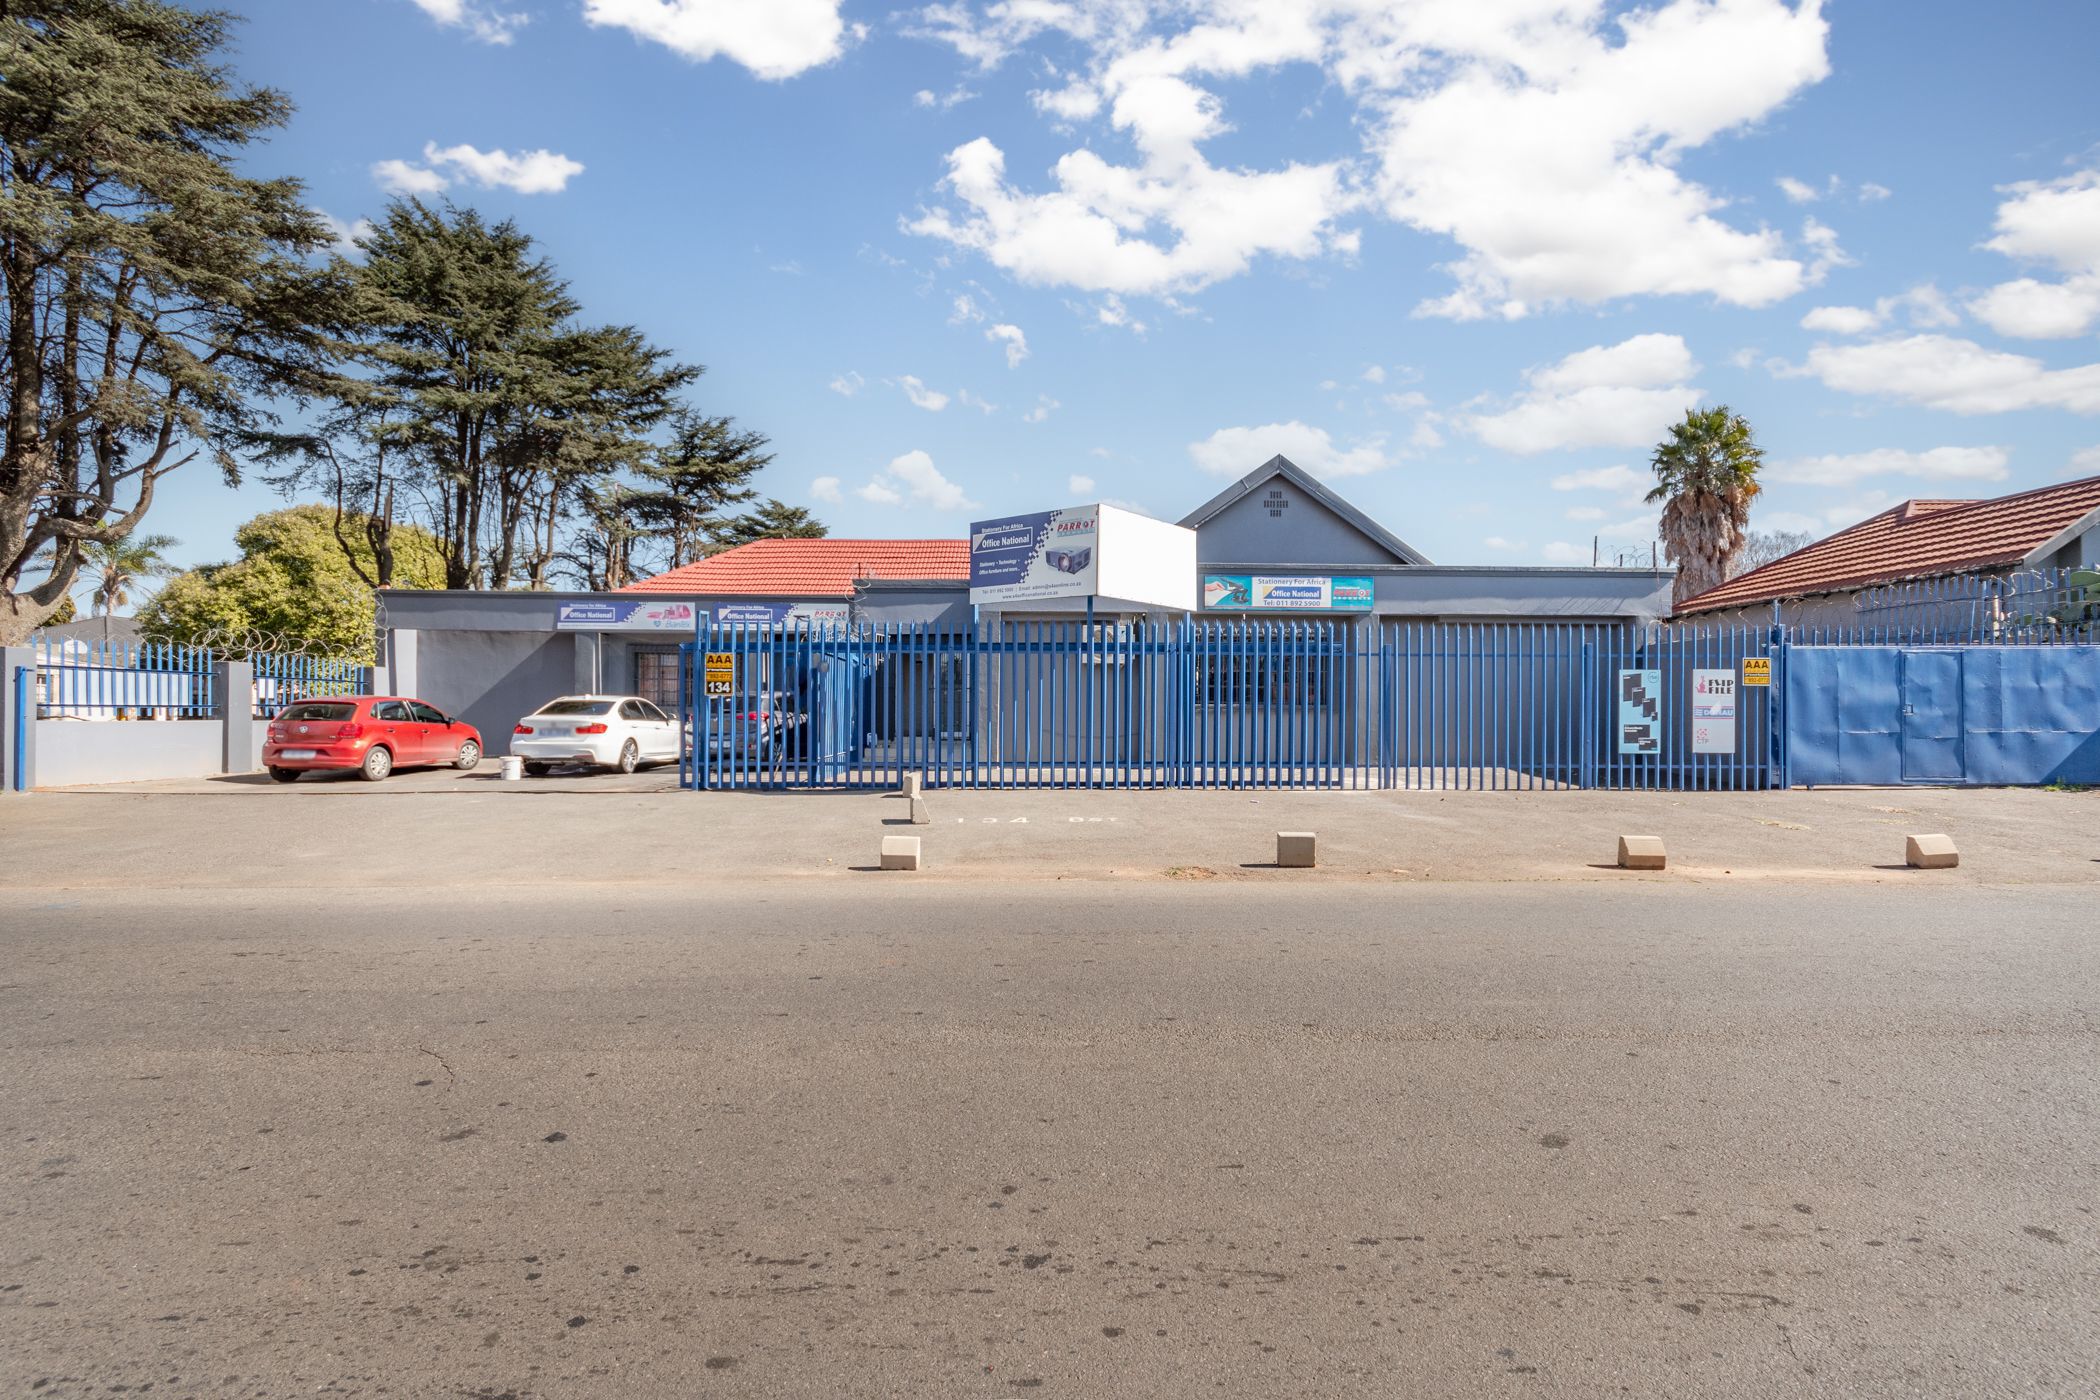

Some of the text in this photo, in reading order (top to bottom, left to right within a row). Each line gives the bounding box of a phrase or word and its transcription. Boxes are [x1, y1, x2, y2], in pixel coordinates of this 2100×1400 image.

[1057, 520, 1095, 532] PARROT
[982, 533, 1030, 548] Office National
[1258, 578, 1292, 586] Stationery
[1292, 590, 1320, 598] National
[707, 655, 732, 664] AAA
[1745, 660, 1769, 668] AAA
[708, 681, 731, 693] 134
